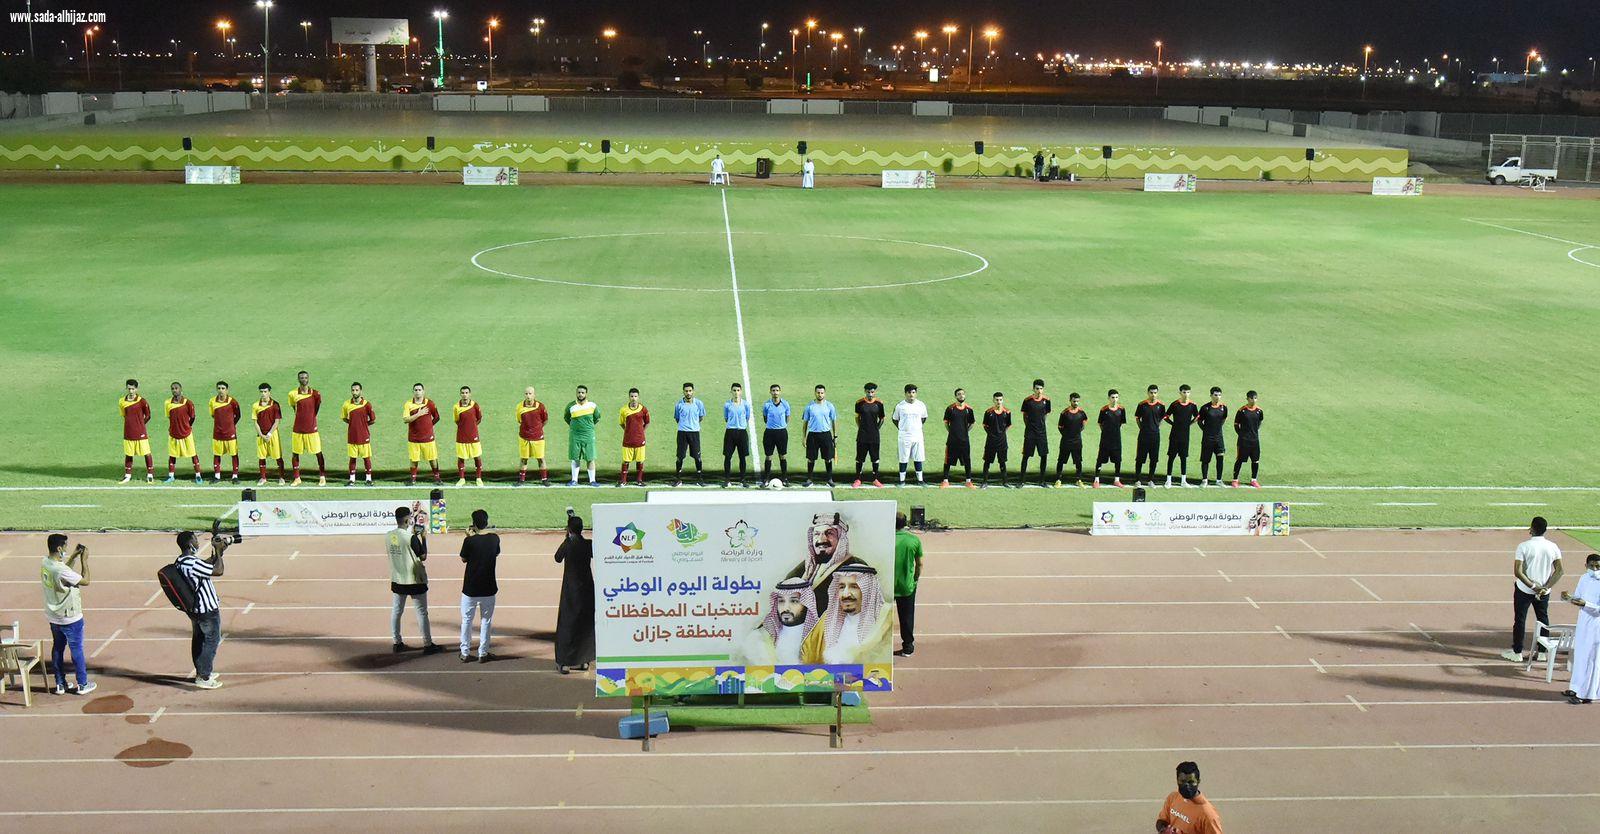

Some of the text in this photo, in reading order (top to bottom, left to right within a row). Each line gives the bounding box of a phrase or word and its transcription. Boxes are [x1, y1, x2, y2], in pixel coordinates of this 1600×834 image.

[350, 511, 371, 520] اليوم
[1169, 512, 1242, 523] بطولة اليوم الوطني
[603, 575, 761, 601] بطولة اليوم الوطني
[605, 602, 759, 620] لمنتخبات المحافظات
[633, 624, 732, 643] بمنطقة جازان
